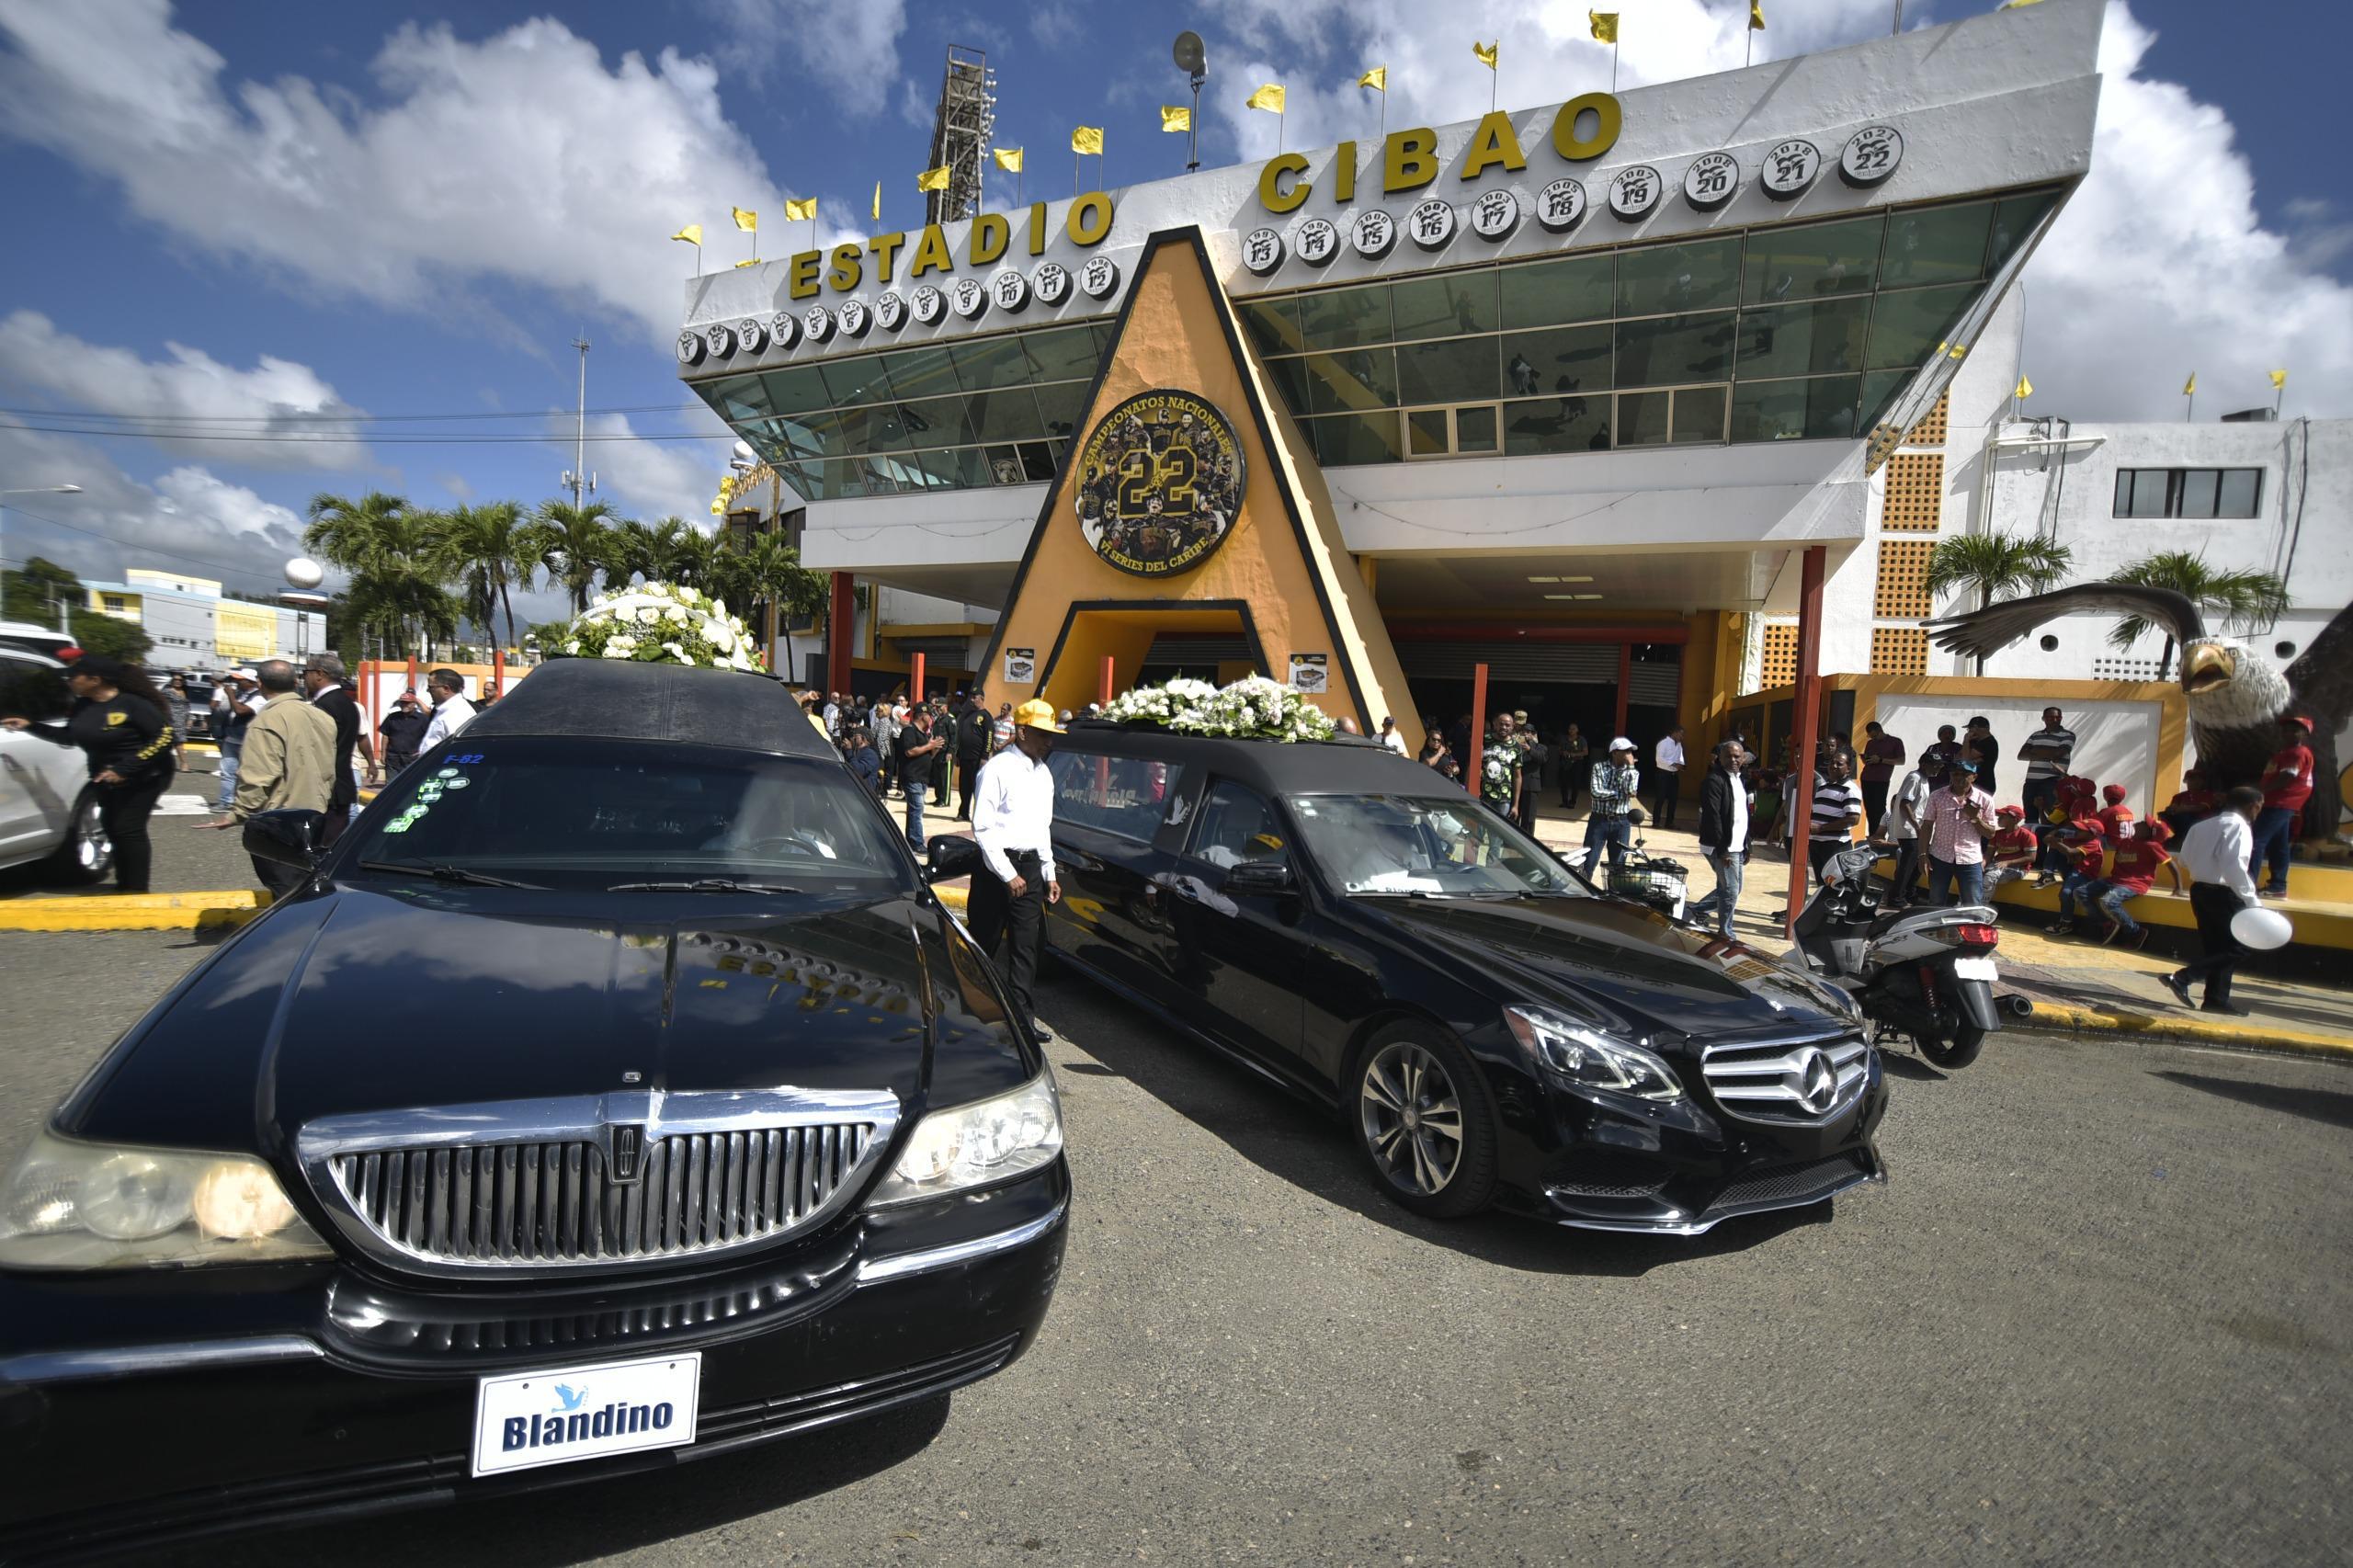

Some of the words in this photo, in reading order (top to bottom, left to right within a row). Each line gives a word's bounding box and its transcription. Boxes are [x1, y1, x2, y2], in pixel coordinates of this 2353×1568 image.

[1851, 129, 1895, 148] 2021
[1769, 144, 1812, 162] 2018
[1854, 150, 1890, 171] 22
[1692, 155, 1733, 173] 2008
[1617, 169, 1654, 185] 2007
[1774, 164, 1805, 183] 21
[1543, 181, 1580, 197] 2005
[1695, 176, 1727, 195] 20
[790, 191, 1114, 300] ESTADIO
[1258, 91, 1622, 214] CIBAO
[1477, 193, 1512, 208] 2003
[1620, 187, 1648, 206] 19
[1415, 204, 1448, 219] 2001
[1548, 199, 1574, 218] 18
[1358, 213, 1388, 228] 2000
[1481, 210, 1506, 228] 17
[1301, 222, 1331, 235] 1998
[1419, 220, 1443, 237] 16
[1247, 231, 1276, 244] 1997
[1360, 231, 1383, 247] 15
[1304, 237, 1326, 255] 14
[1250, 247, 1271, 263] 13
[1086, 259, 1109, 271] 1996
[957, 281, 978, 292] 1986
[999, 275, 1021, 285] 1987
[1042, 281, 1058, 294] 11
[1088, 274, 1106, 288] 12
[961, 295, 971, 308] 9
[1001, 289, 1017, 302] 10
[921, 303, 929, 314] 8
[812, 323, 819, 333] 5
[847, 317, 855, 327] 6
[1086, 395, 1165, 466] CAMPEONATOS
[1168, 396, 1233, 454] NACIONALES
[1117, 446, 1198, 519] 22
[1099, 540, 1110, 556] VI
[1109, 551, 1143, 571] SERIES
[1145, 561, 1168, 573] DEL
[1168, 538, 1209, 568] CARIBE
[442, 754, 485, 764] F-82
[502, 1402, 692, 1452] Blandino
